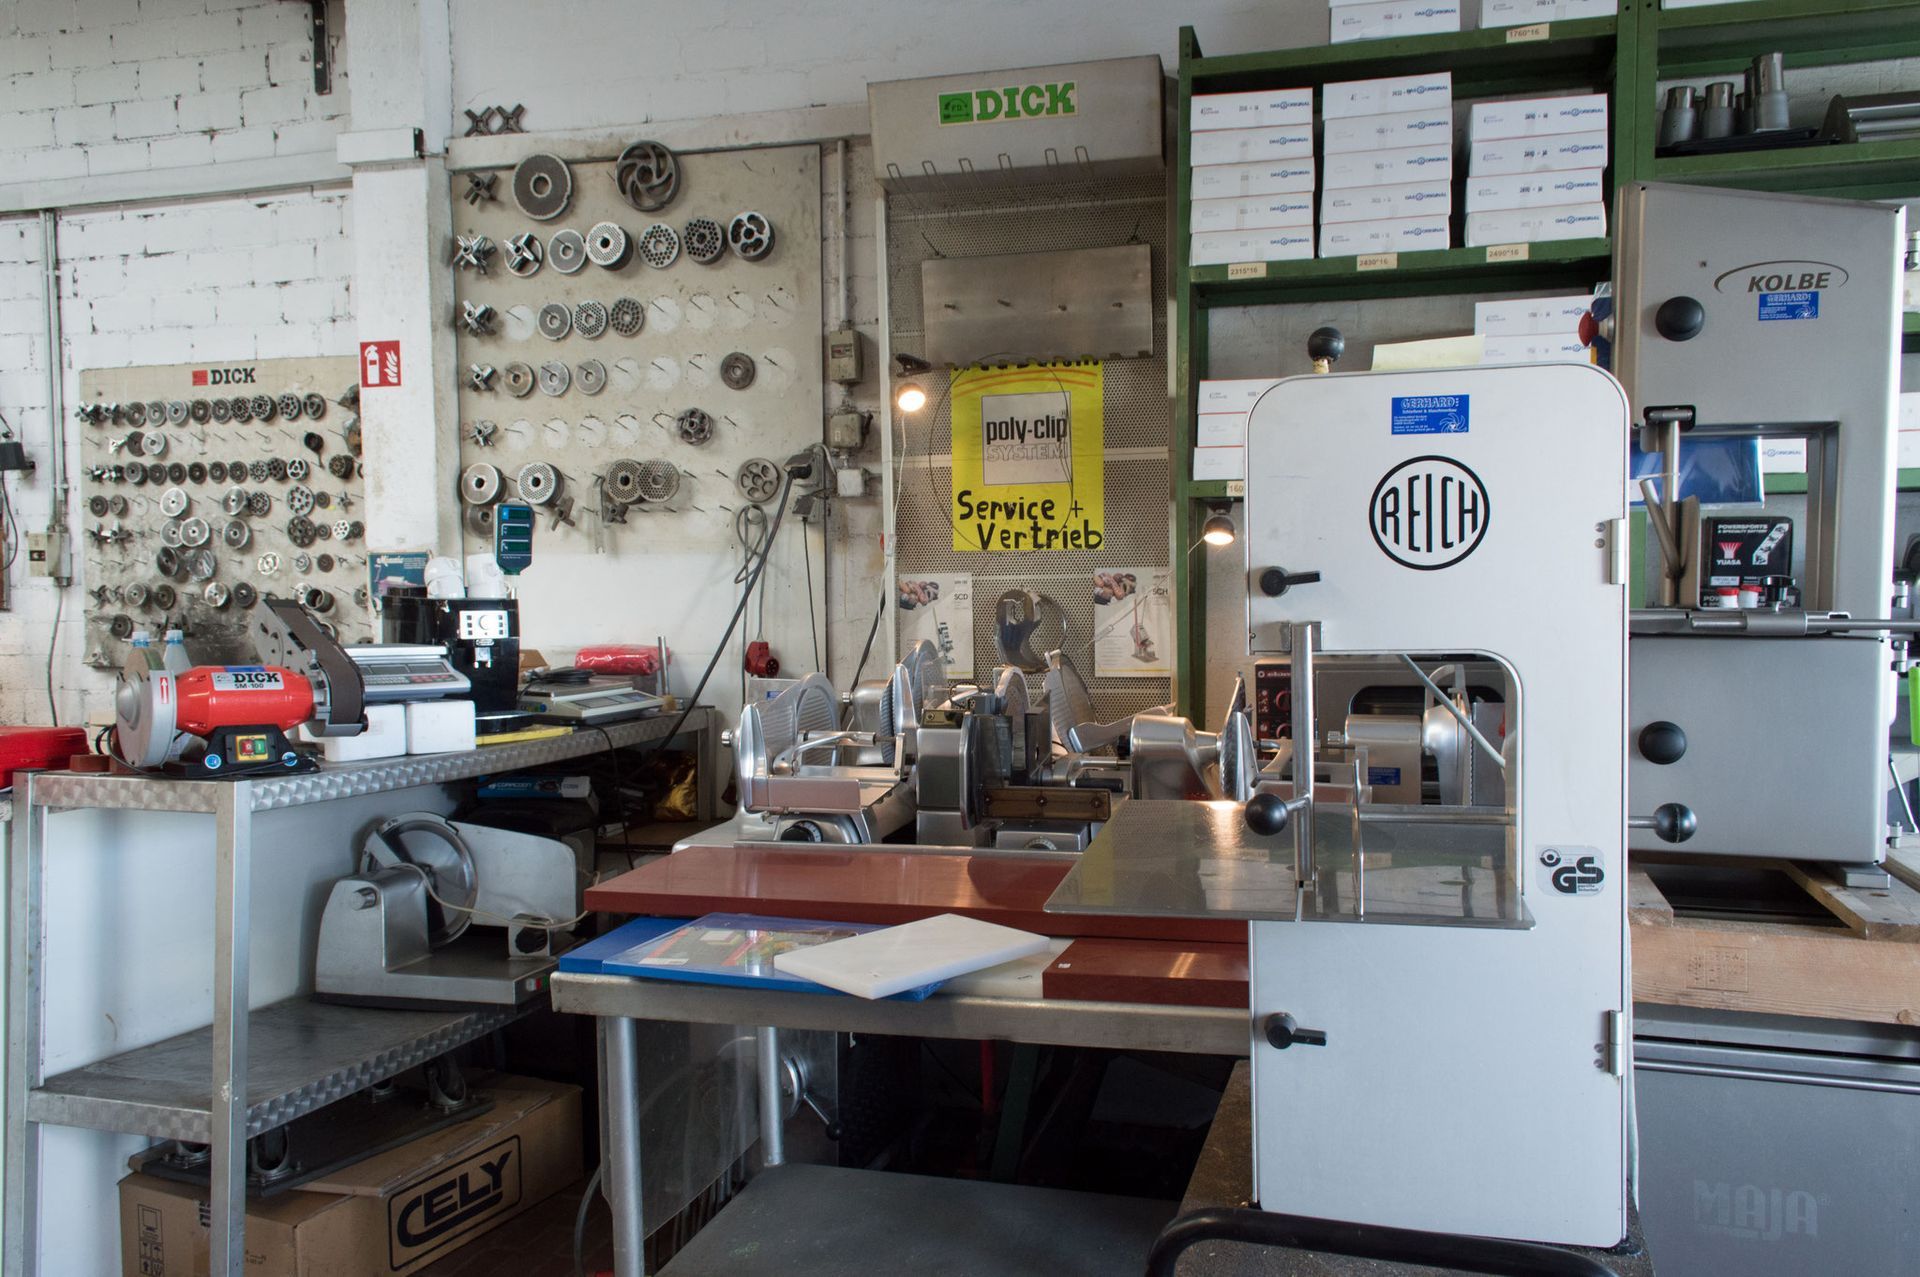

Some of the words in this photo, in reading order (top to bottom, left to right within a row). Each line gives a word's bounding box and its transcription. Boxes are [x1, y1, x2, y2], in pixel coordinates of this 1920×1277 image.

[975, 82, 1075, 121] DICK
[1748, 271, 1831, 293] KOLBE
[210, 366, 256, 385] DICK
[986, 415, 1067, 445] poly-clip
[986, 442, 1068, 462] SYSTEM
[957, 490, 1055, 521] Service
[1071, 500, 1084, 518] +
[1381, 473, 1478, 553] REICH
[976, 519, 1103, 550] Vertrieb
[232, 672, 280, 683] DICK
[1552, 857, 1604, 893] GS
[397, 1150, 513, 1248] CELY
